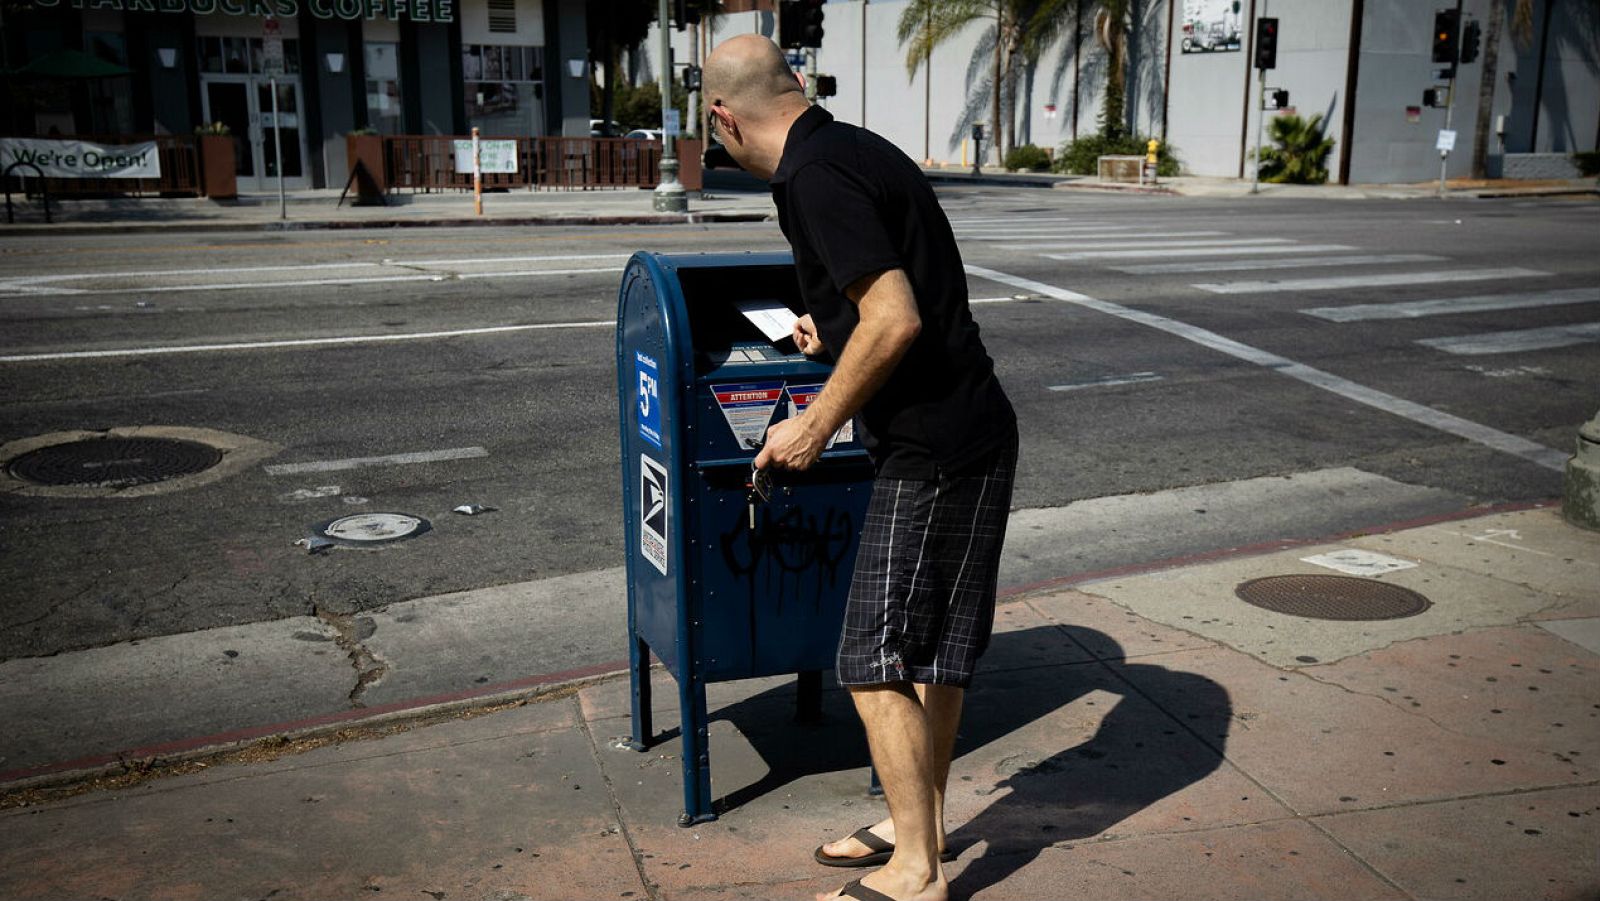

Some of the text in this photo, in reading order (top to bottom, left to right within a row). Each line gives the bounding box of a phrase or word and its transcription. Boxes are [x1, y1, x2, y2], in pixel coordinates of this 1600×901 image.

[309, 0, 454, 22] COFFEE
[13, 149, 148, 170] We're Open!
[730, 391, 769, 401] ATTENTION
